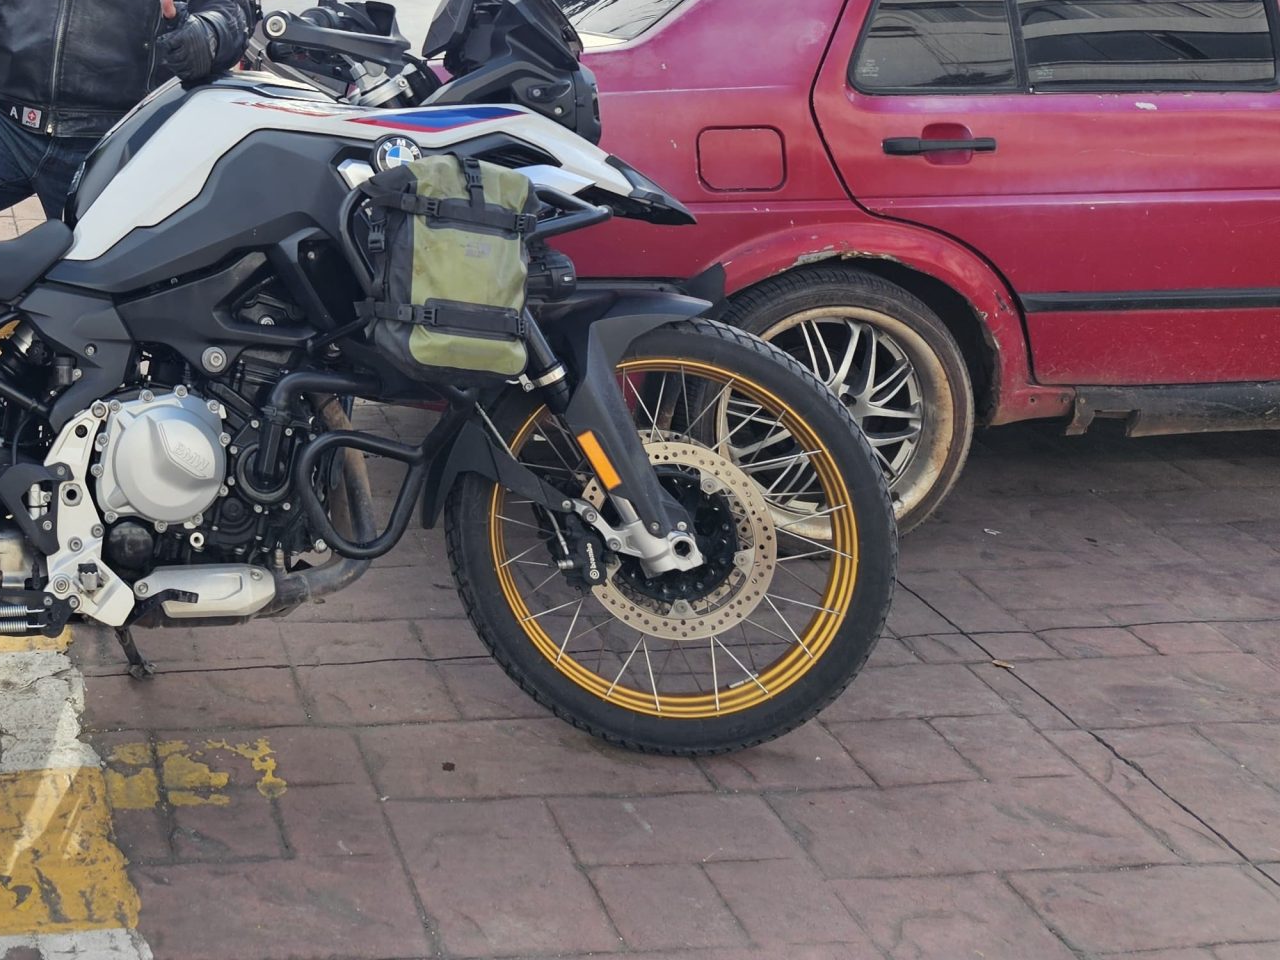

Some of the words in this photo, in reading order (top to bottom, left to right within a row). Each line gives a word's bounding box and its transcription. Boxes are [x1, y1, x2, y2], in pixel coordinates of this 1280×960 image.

[10, 106, 18, 119] A
[175, 442, 210, 472] BMW
[586, 542, 597, 569] brembo
